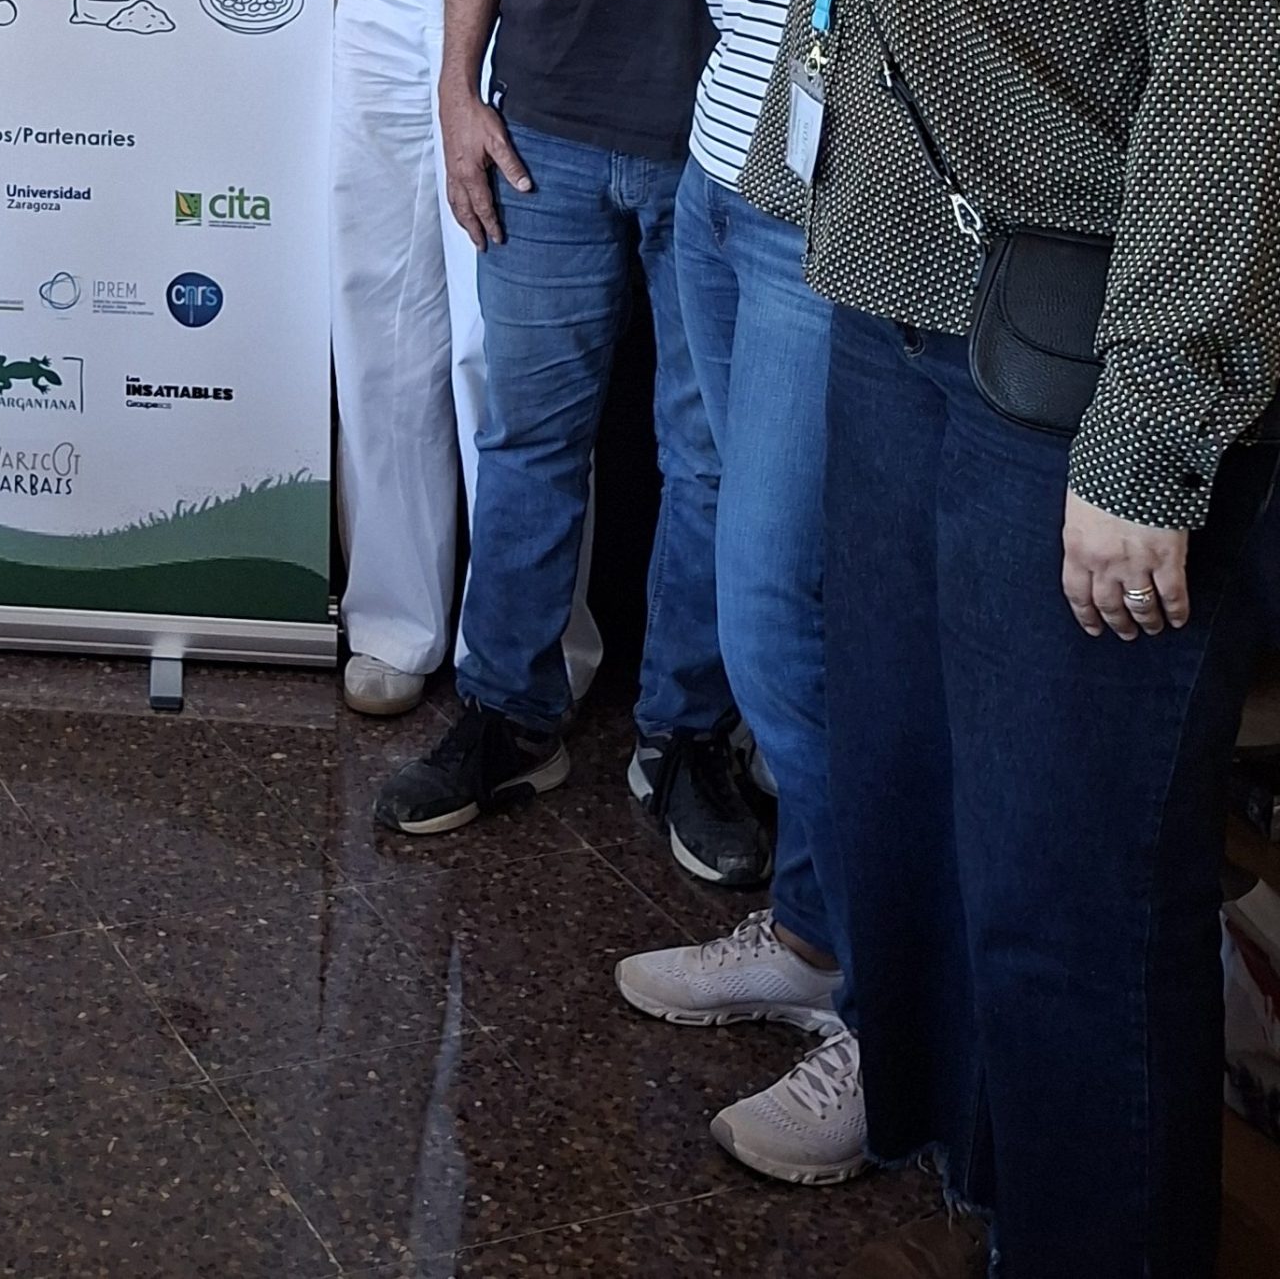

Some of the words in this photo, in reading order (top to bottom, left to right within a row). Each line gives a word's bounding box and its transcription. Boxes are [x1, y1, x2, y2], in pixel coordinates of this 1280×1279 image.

[6, 184, 92, 201] Universidad
[6, 198, 62, 213] Zaragoza
[209, 186, 271, 220] cita
[92, 280, 137, 299] IPREM
[171, 283, 218, 307] cnrs
[126, 383, 234, 401] INSATIABLES
